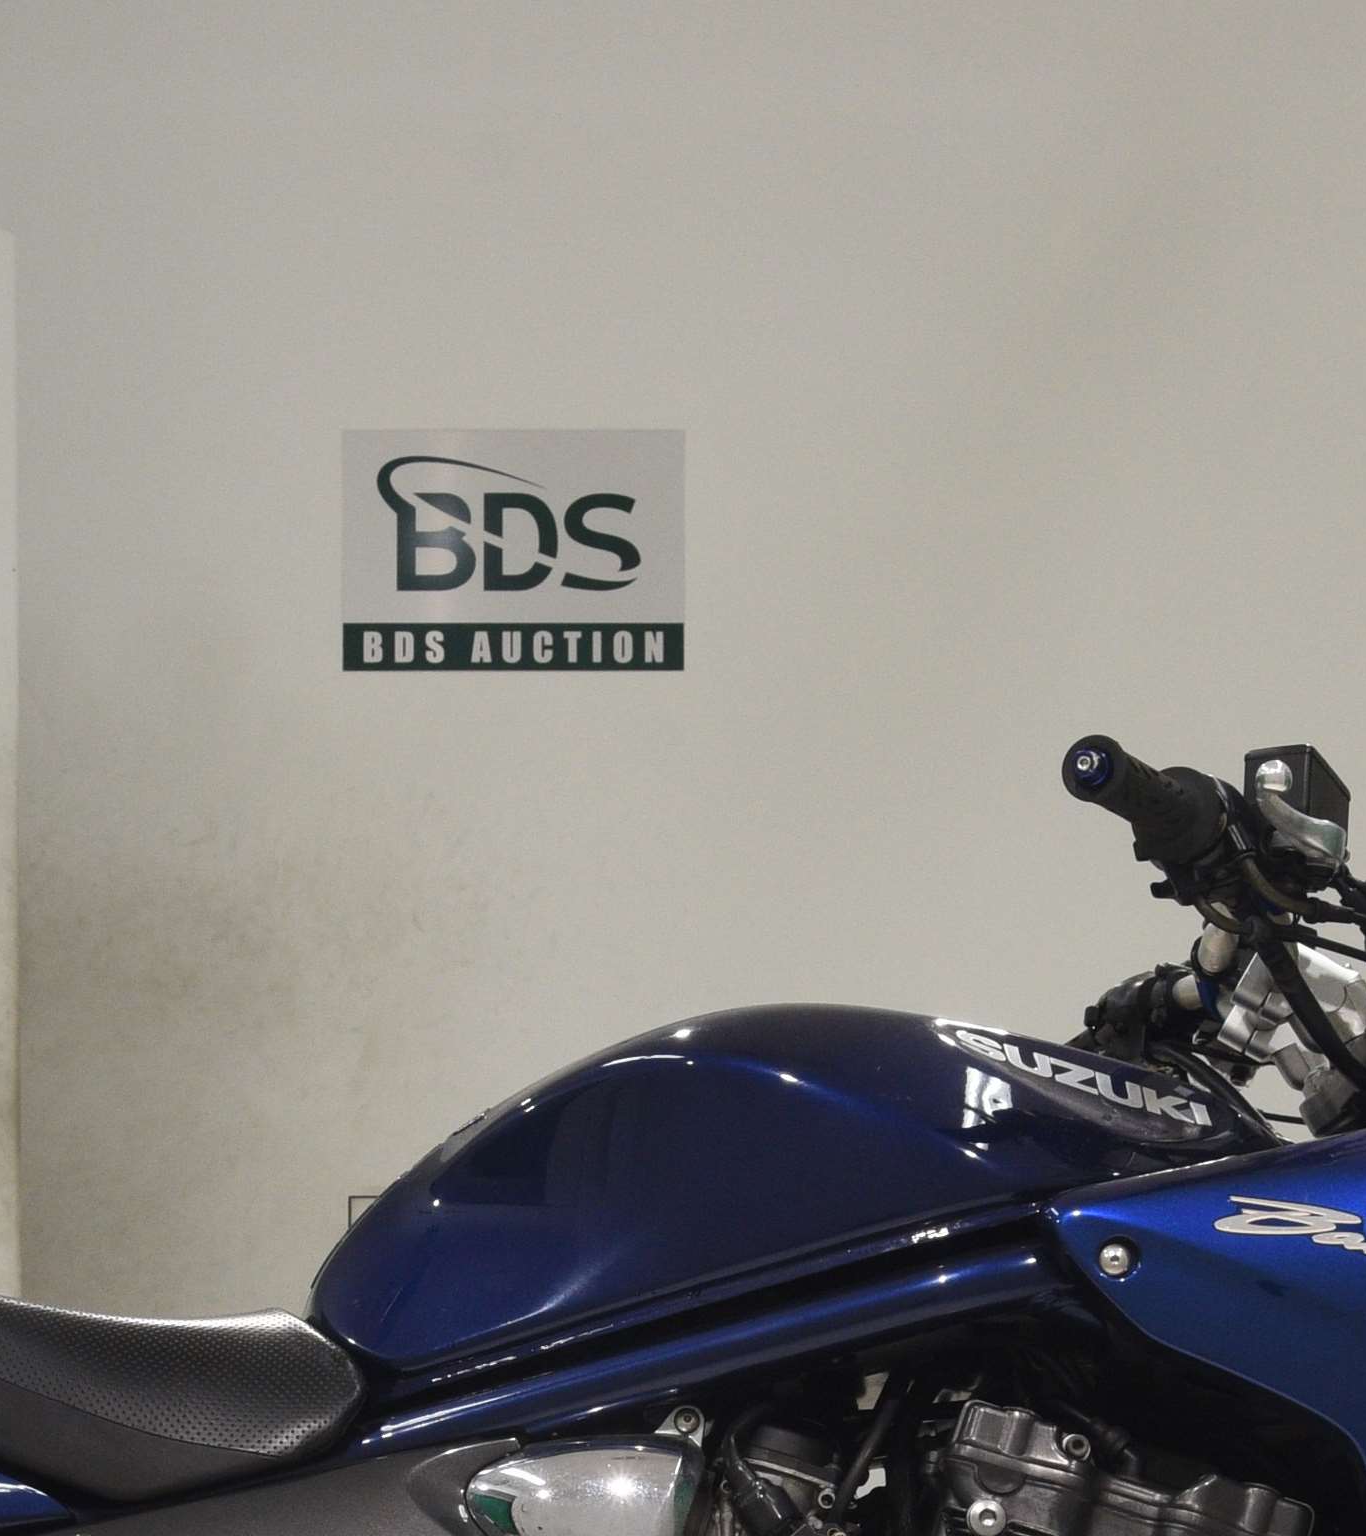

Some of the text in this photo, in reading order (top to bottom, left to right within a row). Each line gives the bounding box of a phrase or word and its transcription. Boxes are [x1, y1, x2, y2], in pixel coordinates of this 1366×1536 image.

[377, 456, 641, 591] BDS
[363, 631, 665, 664] BDS AUCTION
[956, 1030, 1212, 1126] SUZUKI
